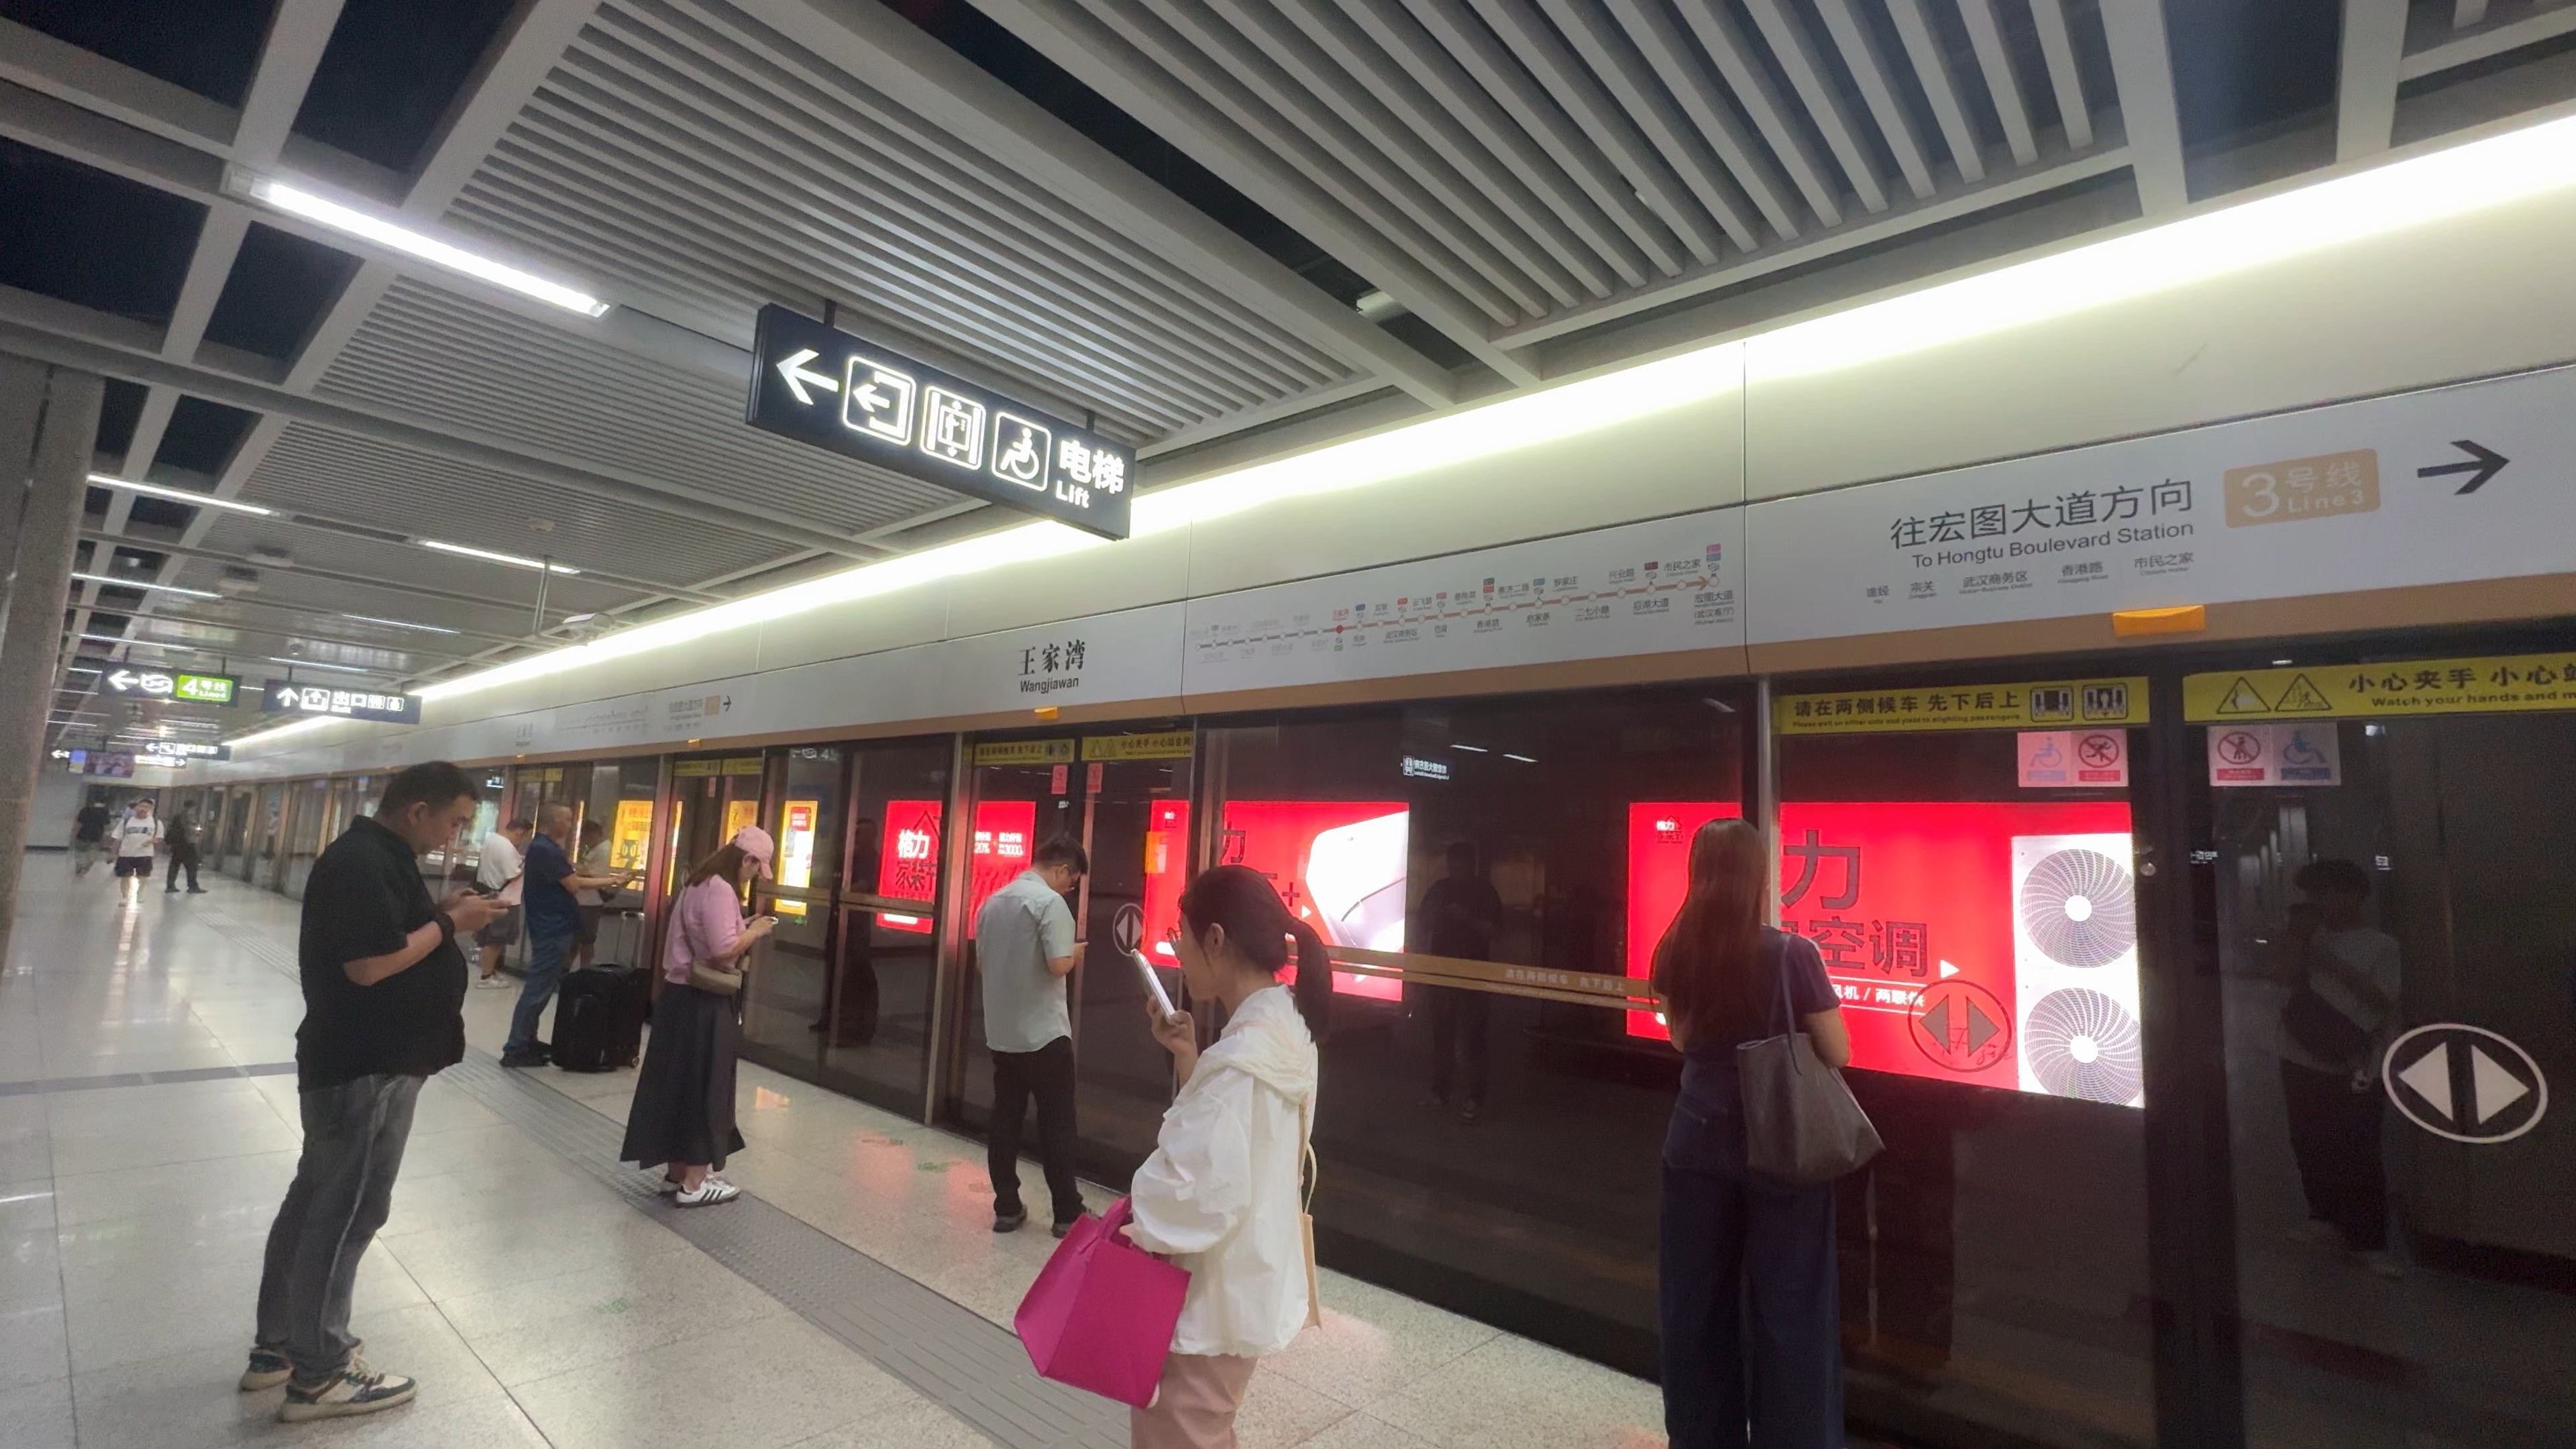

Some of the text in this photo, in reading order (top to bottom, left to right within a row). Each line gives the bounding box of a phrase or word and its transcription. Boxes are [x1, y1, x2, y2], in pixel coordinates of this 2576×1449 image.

[1058, 440, 1125, 495] 电梯
[1055, 480, 1091, 510] Lift
[1889, 478, 2194, 550] 往宏图大道方向
[1911, 520, 2195, 569] To Hongtu Boulevard Station
[1664, 558, 1702, 572] 市民之家
[2061, 561, 2104, 578] 香港路
[2134, 551, 2195, 570] 市民之家
[1963, 570, 2029, 588] 武汉商务区
[1017, 639, 1086, 676] 王家湾
[1020, 676, 1079, 694] Wangjiawan
[2349, 668, 2477, 694] 小心夹手
[332, 691, 368, 708] 出口
[1793, 690, 2020, 717] 请在两侧候车 先下后上
[2371, 697, 2421, 708] Watch
[2424, 695, 2463, 707] your
[2467, 693, 2520, 704] hands
[2522, 691, 2557, 701] and
[897, 828, 930, 859] 格力
[1780, 828, 1861, 910] 力
[1781, 916, 1928, 977] 空调
